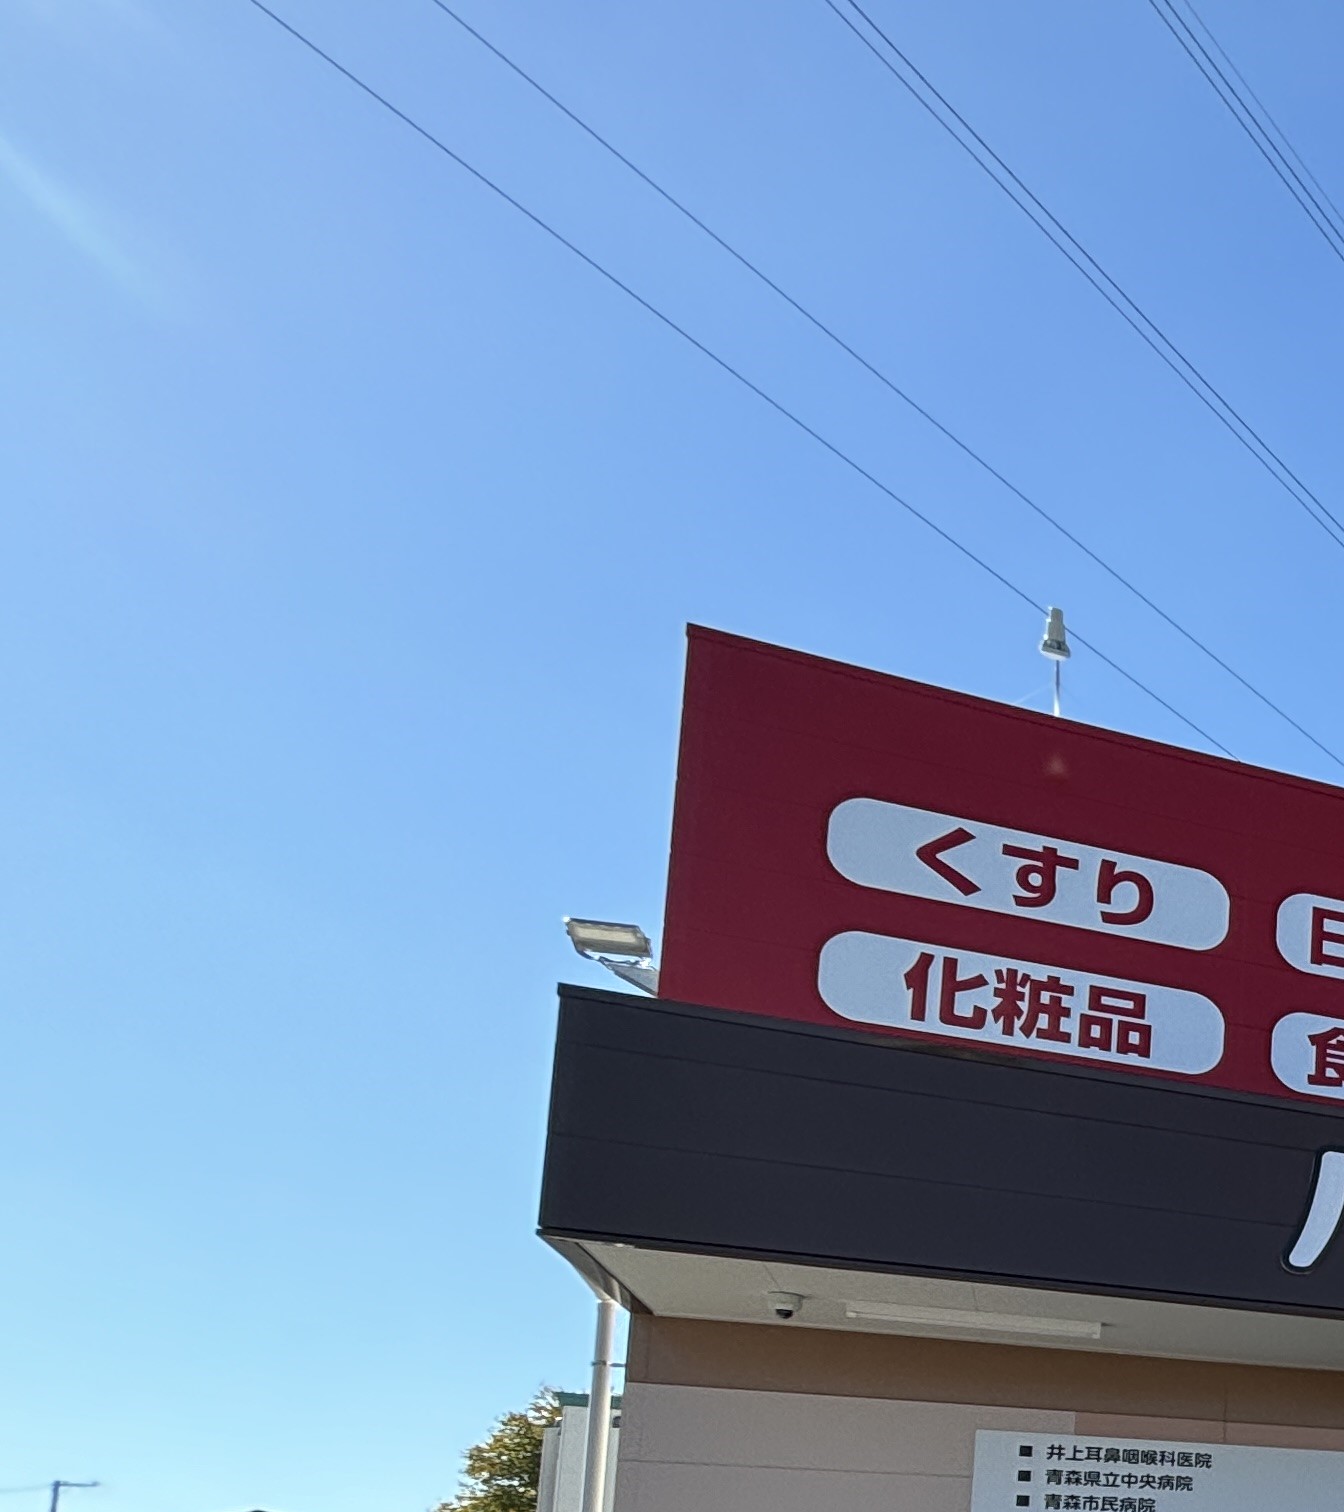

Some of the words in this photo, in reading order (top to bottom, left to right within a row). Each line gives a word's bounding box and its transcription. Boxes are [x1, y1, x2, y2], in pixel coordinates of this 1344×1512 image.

[915, 826, 1154, 926] くすり
[904, 950, 1153, 1060] 化粧品
[1044, 1470, 1194, 1492] 青森県立中央病院
[1046, 1445, 1213, 1469] 井上耳鼻咽喉科医院
